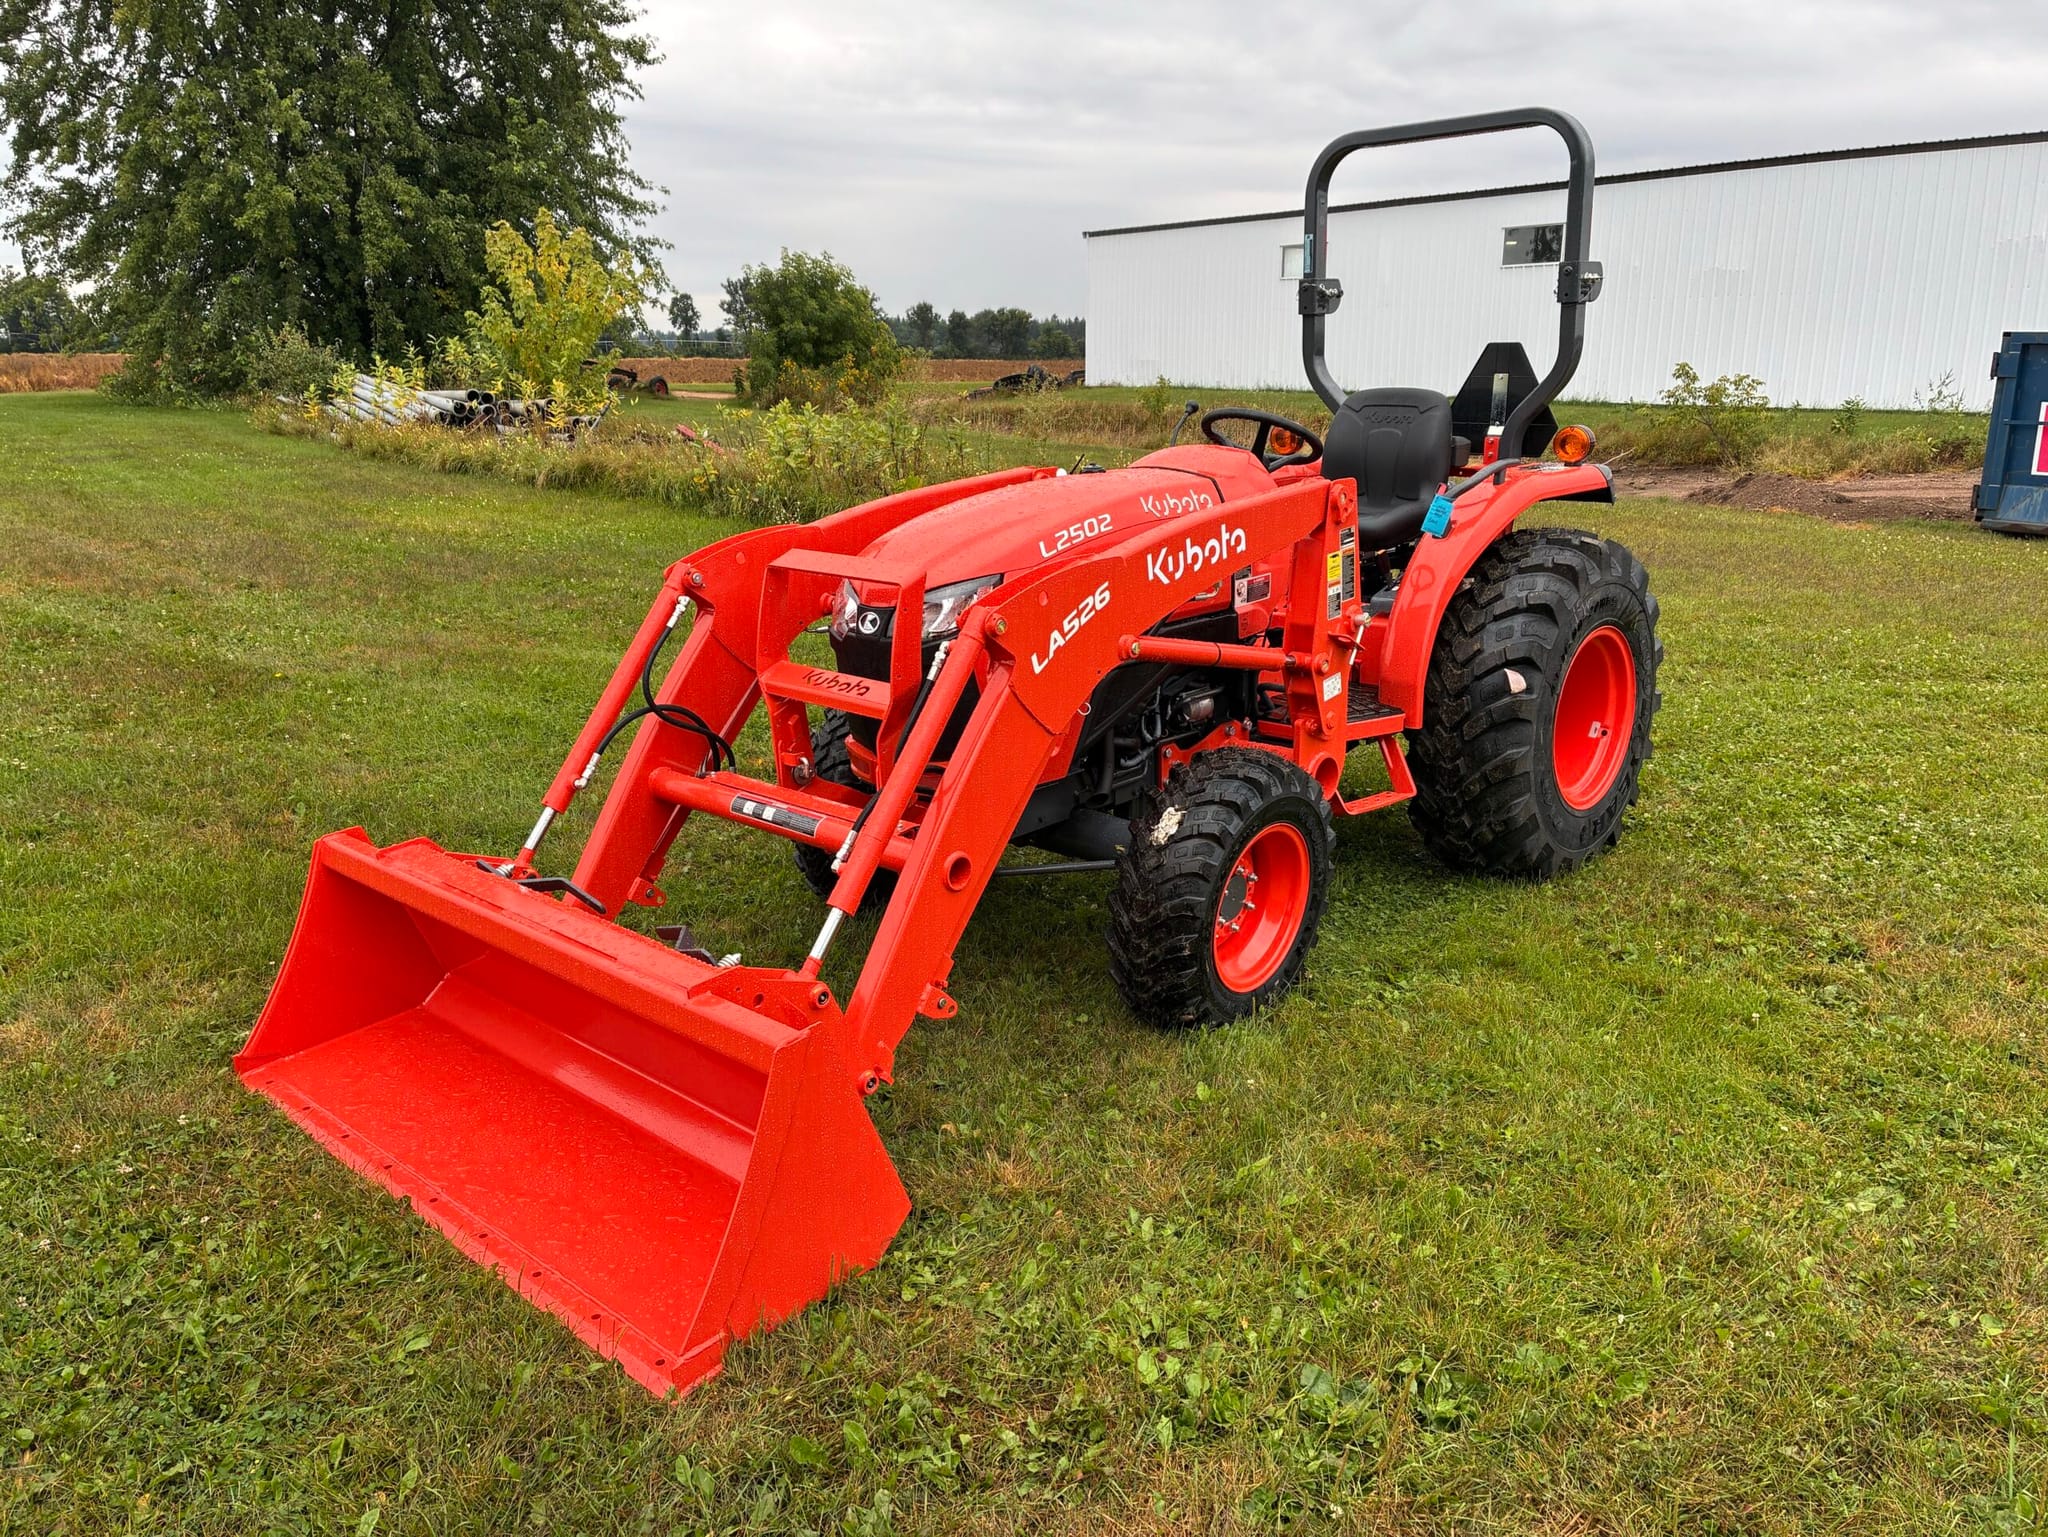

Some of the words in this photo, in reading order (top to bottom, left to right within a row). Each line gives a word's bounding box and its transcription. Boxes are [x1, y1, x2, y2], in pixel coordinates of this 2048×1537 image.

[1139, 489, 1213, 517] Kubota
[1038, 513, 1113, 558] L2502
[1146, 523, 1246, 584] Kubota
[1030, 581, 1111, 675] LA526
[803, 669, 870, 696] Kubota
